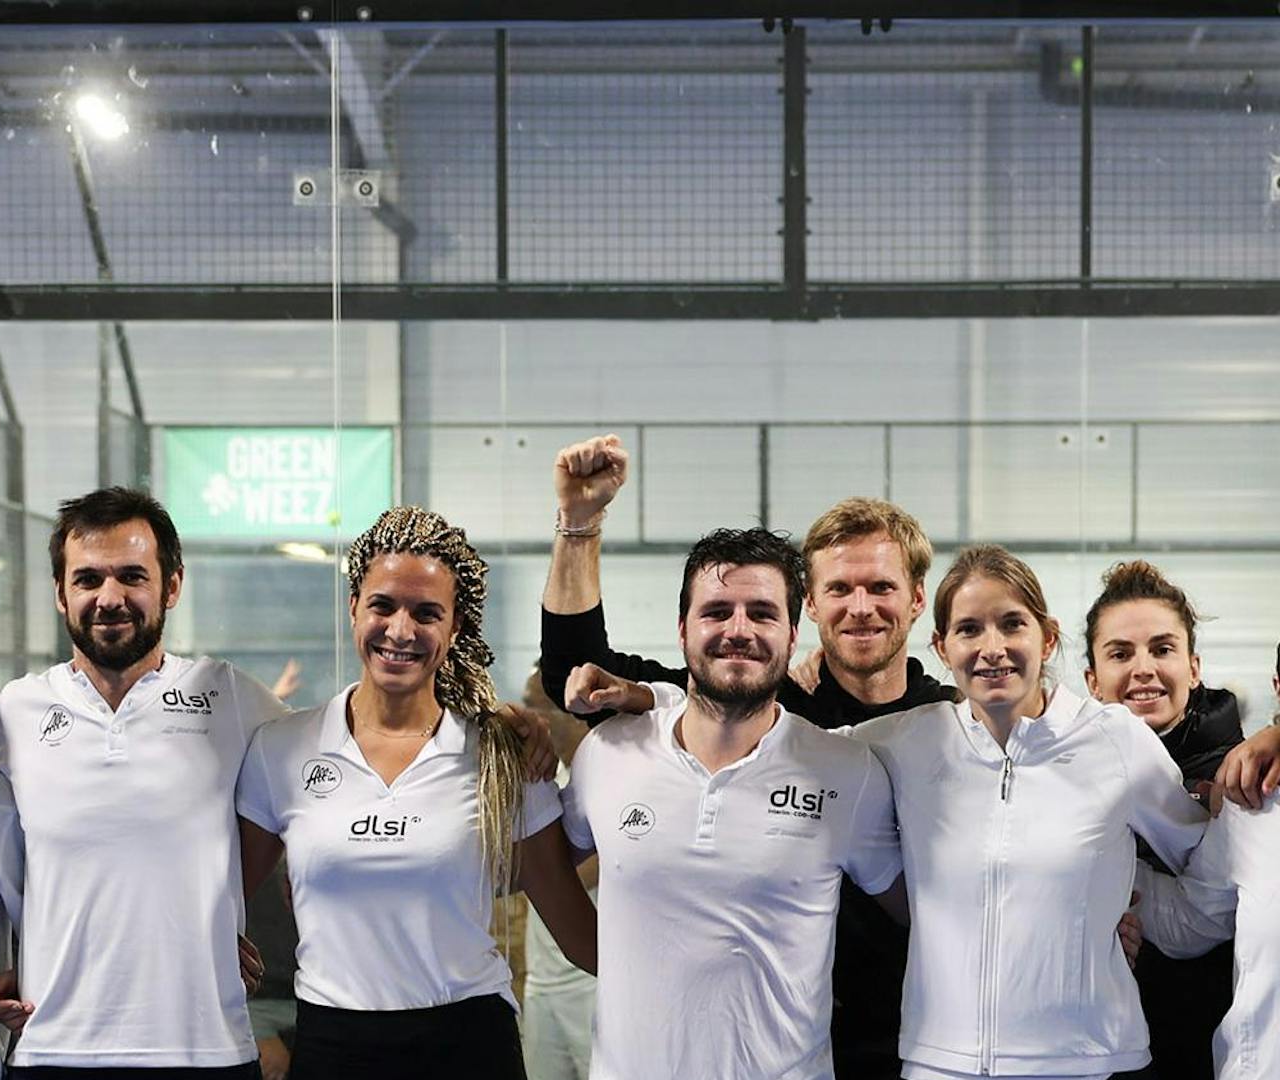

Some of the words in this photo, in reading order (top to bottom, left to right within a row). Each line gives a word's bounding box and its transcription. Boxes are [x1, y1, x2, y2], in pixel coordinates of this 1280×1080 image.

[227, 436, 336, 478] GREEN
[242, 480, 335, 525] WEEZ
[770, 785, 824, 813] dlsi
[351, 815, 407, 836] dlsi
